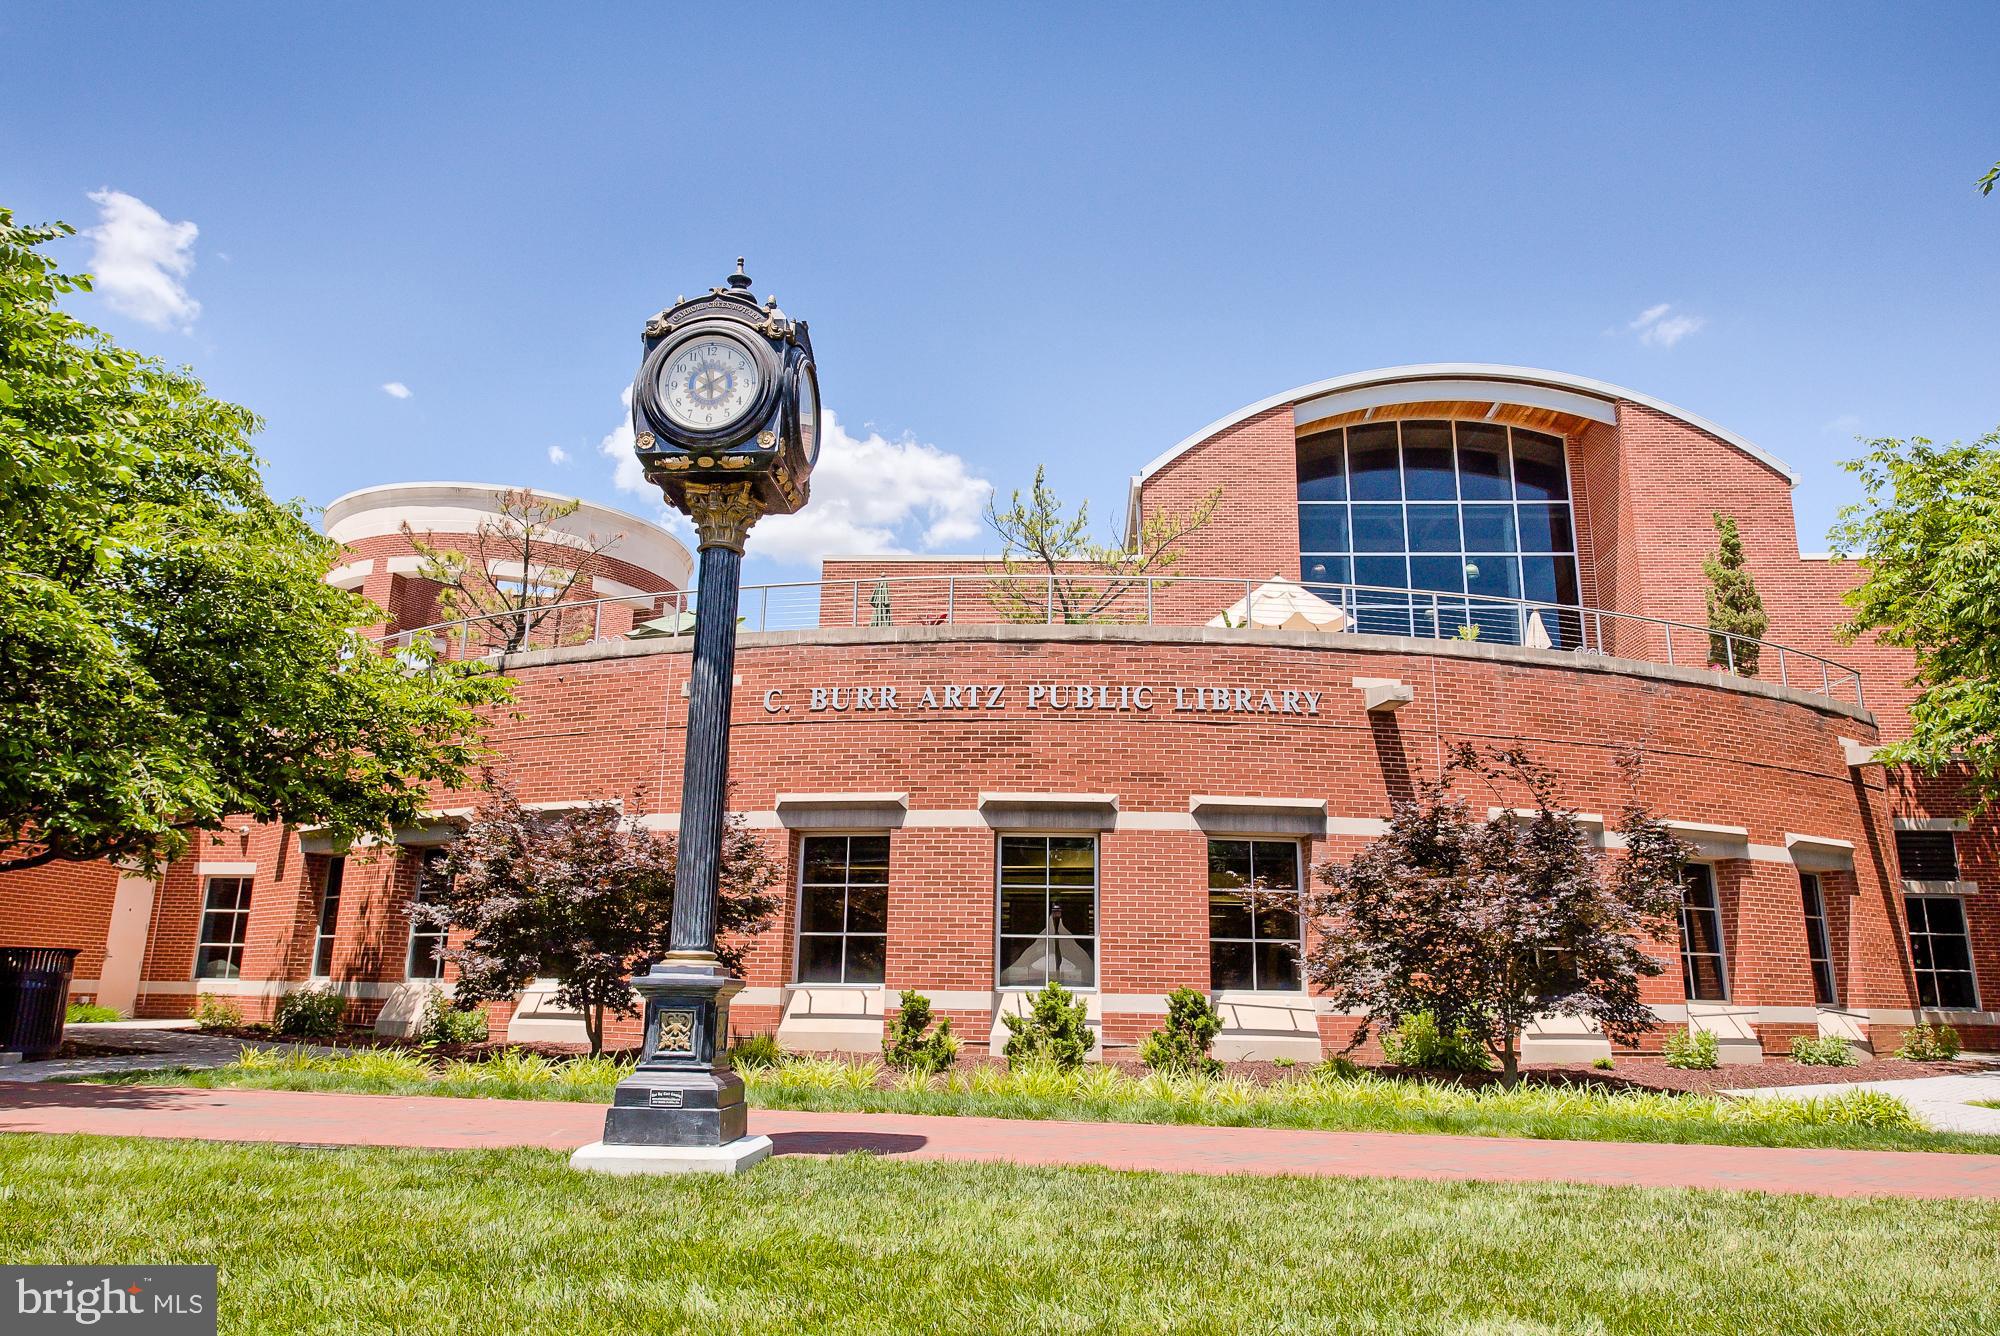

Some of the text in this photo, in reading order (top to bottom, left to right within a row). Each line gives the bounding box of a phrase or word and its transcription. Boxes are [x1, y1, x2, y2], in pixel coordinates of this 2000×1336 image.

[672, 303, 706, 321] CARROLL
[732, 303, 761, 320] ROTARY
[707, 347, 717, 356] 12
[728, 351, 732, 360] 1
[689, 352, 697, 361] 11
[676, 364, 686, 373] 10
[738, 361, 746, 370] 2
[671, 382, 678, 390] 9
[743, 379, 750, 388] 3
[675, 398, 682, 407] 8
[736, 396, 742, 405] 4
[688, 410, 693, 418] 7
[724, 408, 730, 417] 5
[705, 413, 712, 422] 6
[764, 685, 1322, 716] C. BURR ARTZ PUBLIC LIBRARY
